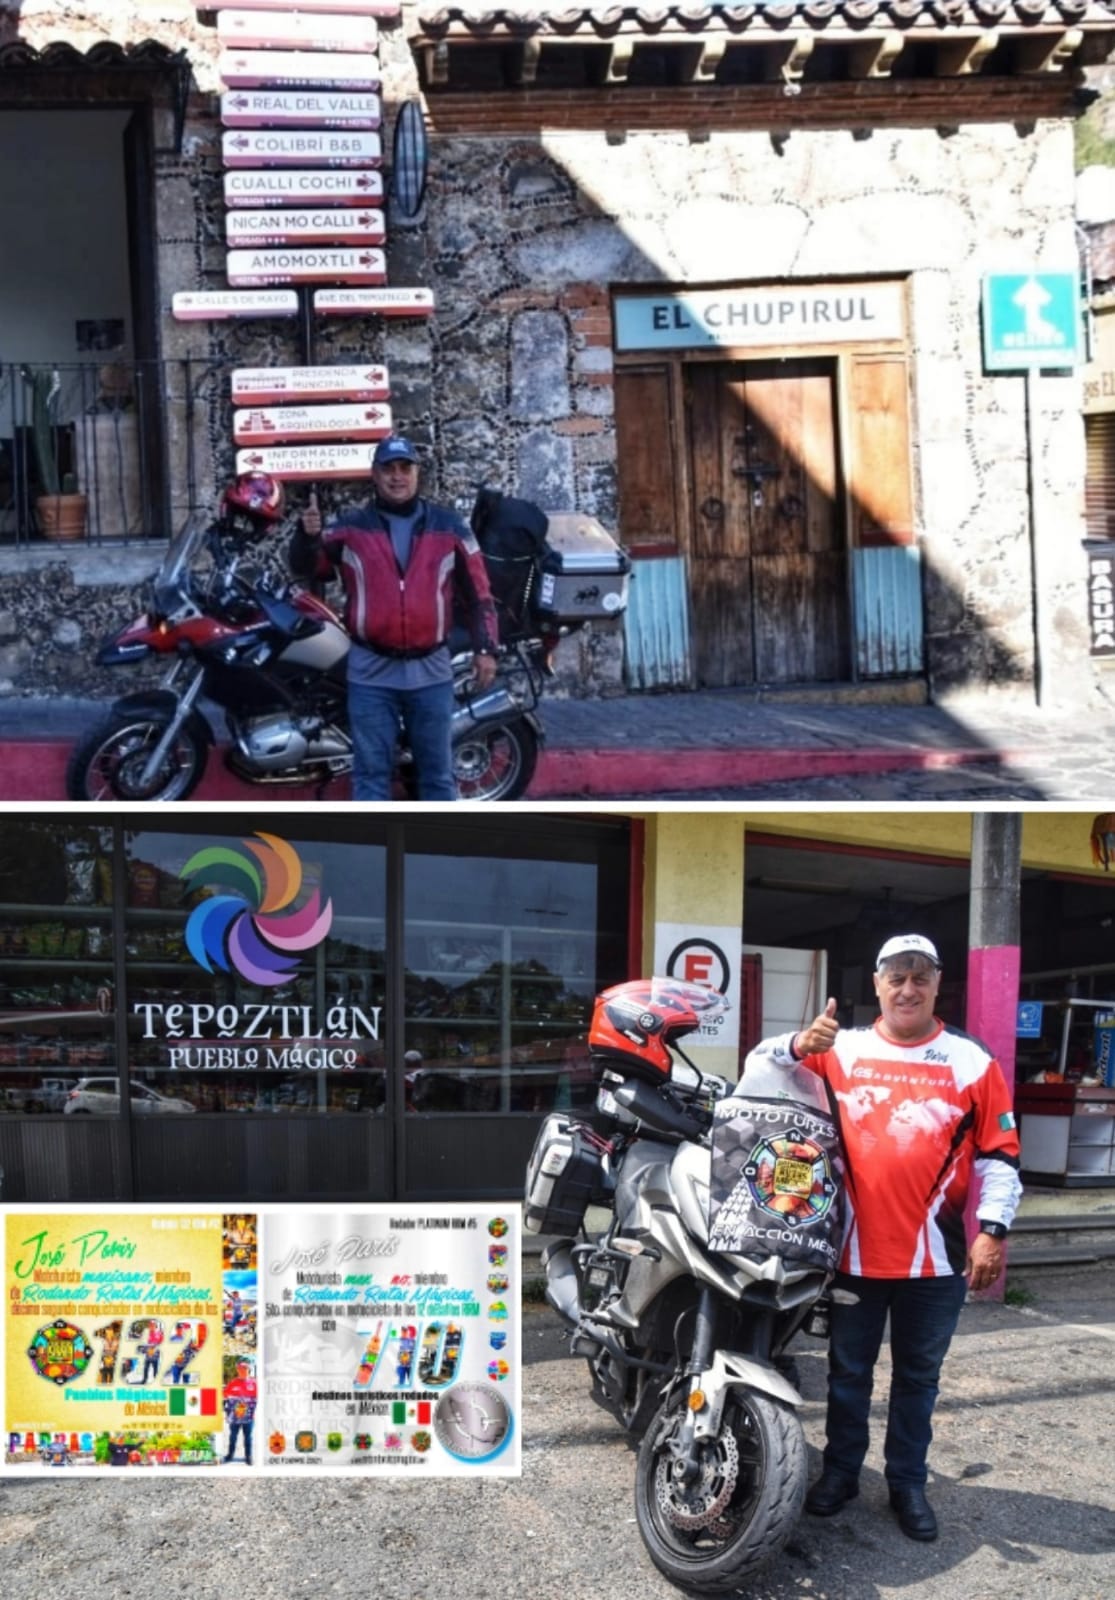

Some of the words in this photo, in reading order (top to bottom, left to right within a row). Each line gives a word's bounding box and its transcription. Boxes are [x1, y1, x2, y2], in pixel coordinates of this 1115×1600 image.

[253, 97, 290, 109] REAL
[296, 97, 323, 110] DEL
[328, 98, 375, 111] VALLE
[255, 137, 324, 151] COLIBRÍ
[330, 138, 362, 151] B&B
[231, 177, 292, 190] CUALLI
[298, 177, 352, 189] COCHI
[233, 216, 280, 229] NICAN
[285, 215, 308, 228] MO
[312, 215, 354, 228] CALLI
[251, 254, 355, 268] AMOMOXTLI
[652, 305, 690, 330] EL
[704, 298, 875, 327] CHUPIRUL
[292, 368, 357, 378] PRESIDENCIA
[292, 379, 346, 389] MUNICIPAL
[278, 410, 308, 419] ZONA
[685, 954, 713, 988] E
[719, 1107, 838, 1142] MOTOTURIS
[744, 1225, 804, 1245] ACCIÓN
